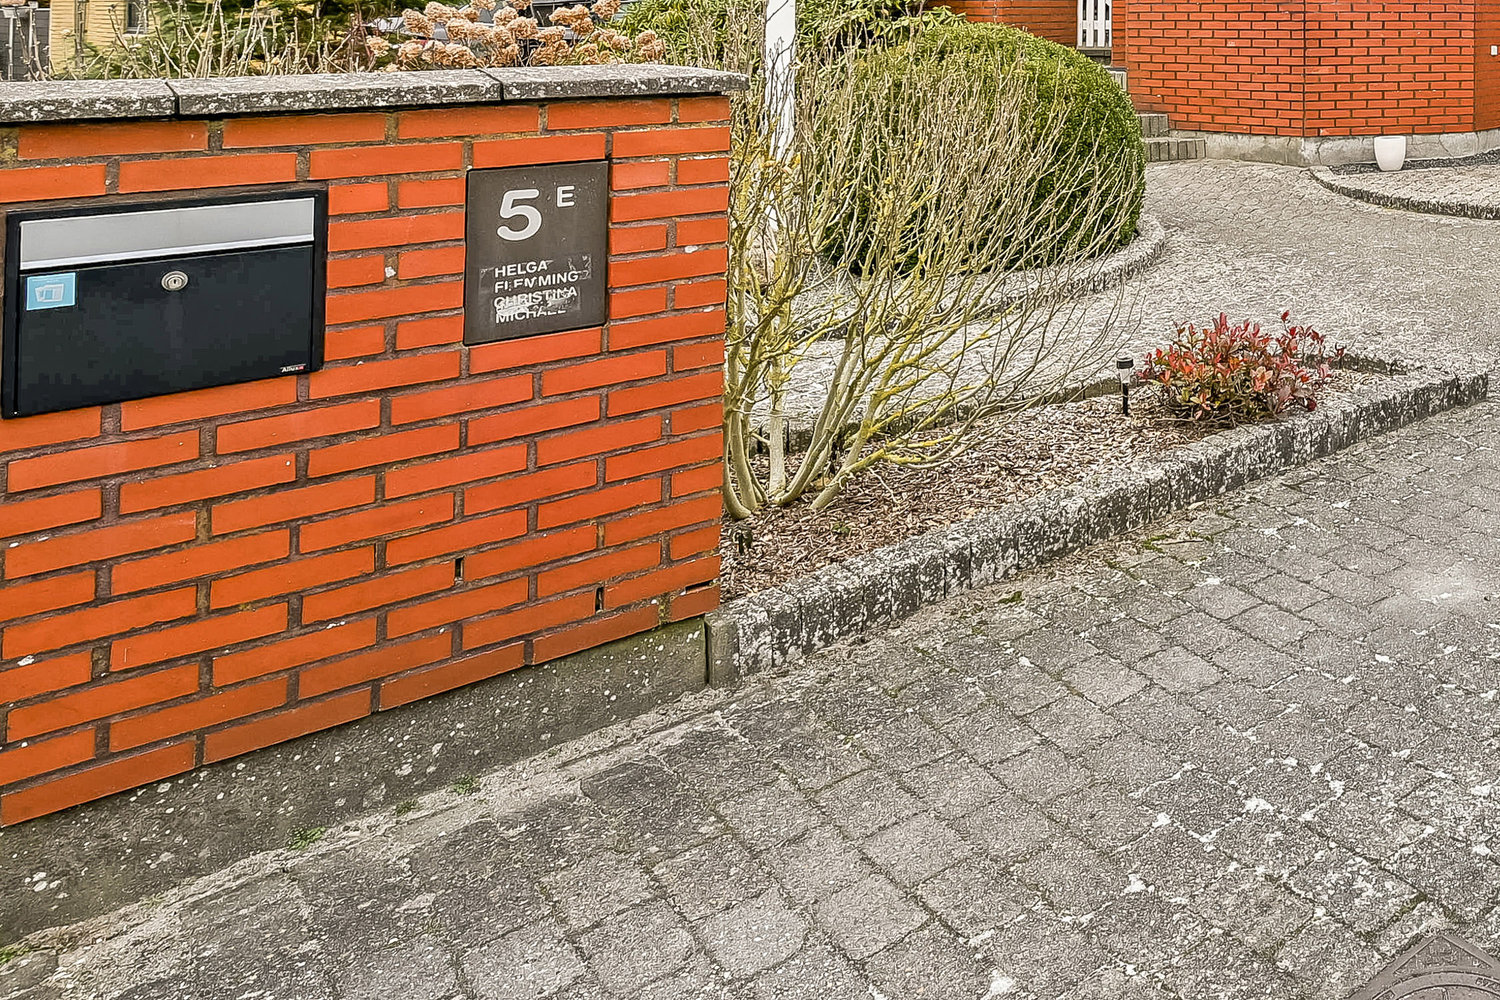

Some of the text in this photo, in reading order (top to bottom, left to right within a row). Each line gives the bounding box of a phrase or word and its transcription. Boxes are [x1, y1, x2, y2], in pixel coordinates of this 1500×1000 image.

[496, 185, 576, 241] 5 E
[495, 260, 548, 278] HELGA
